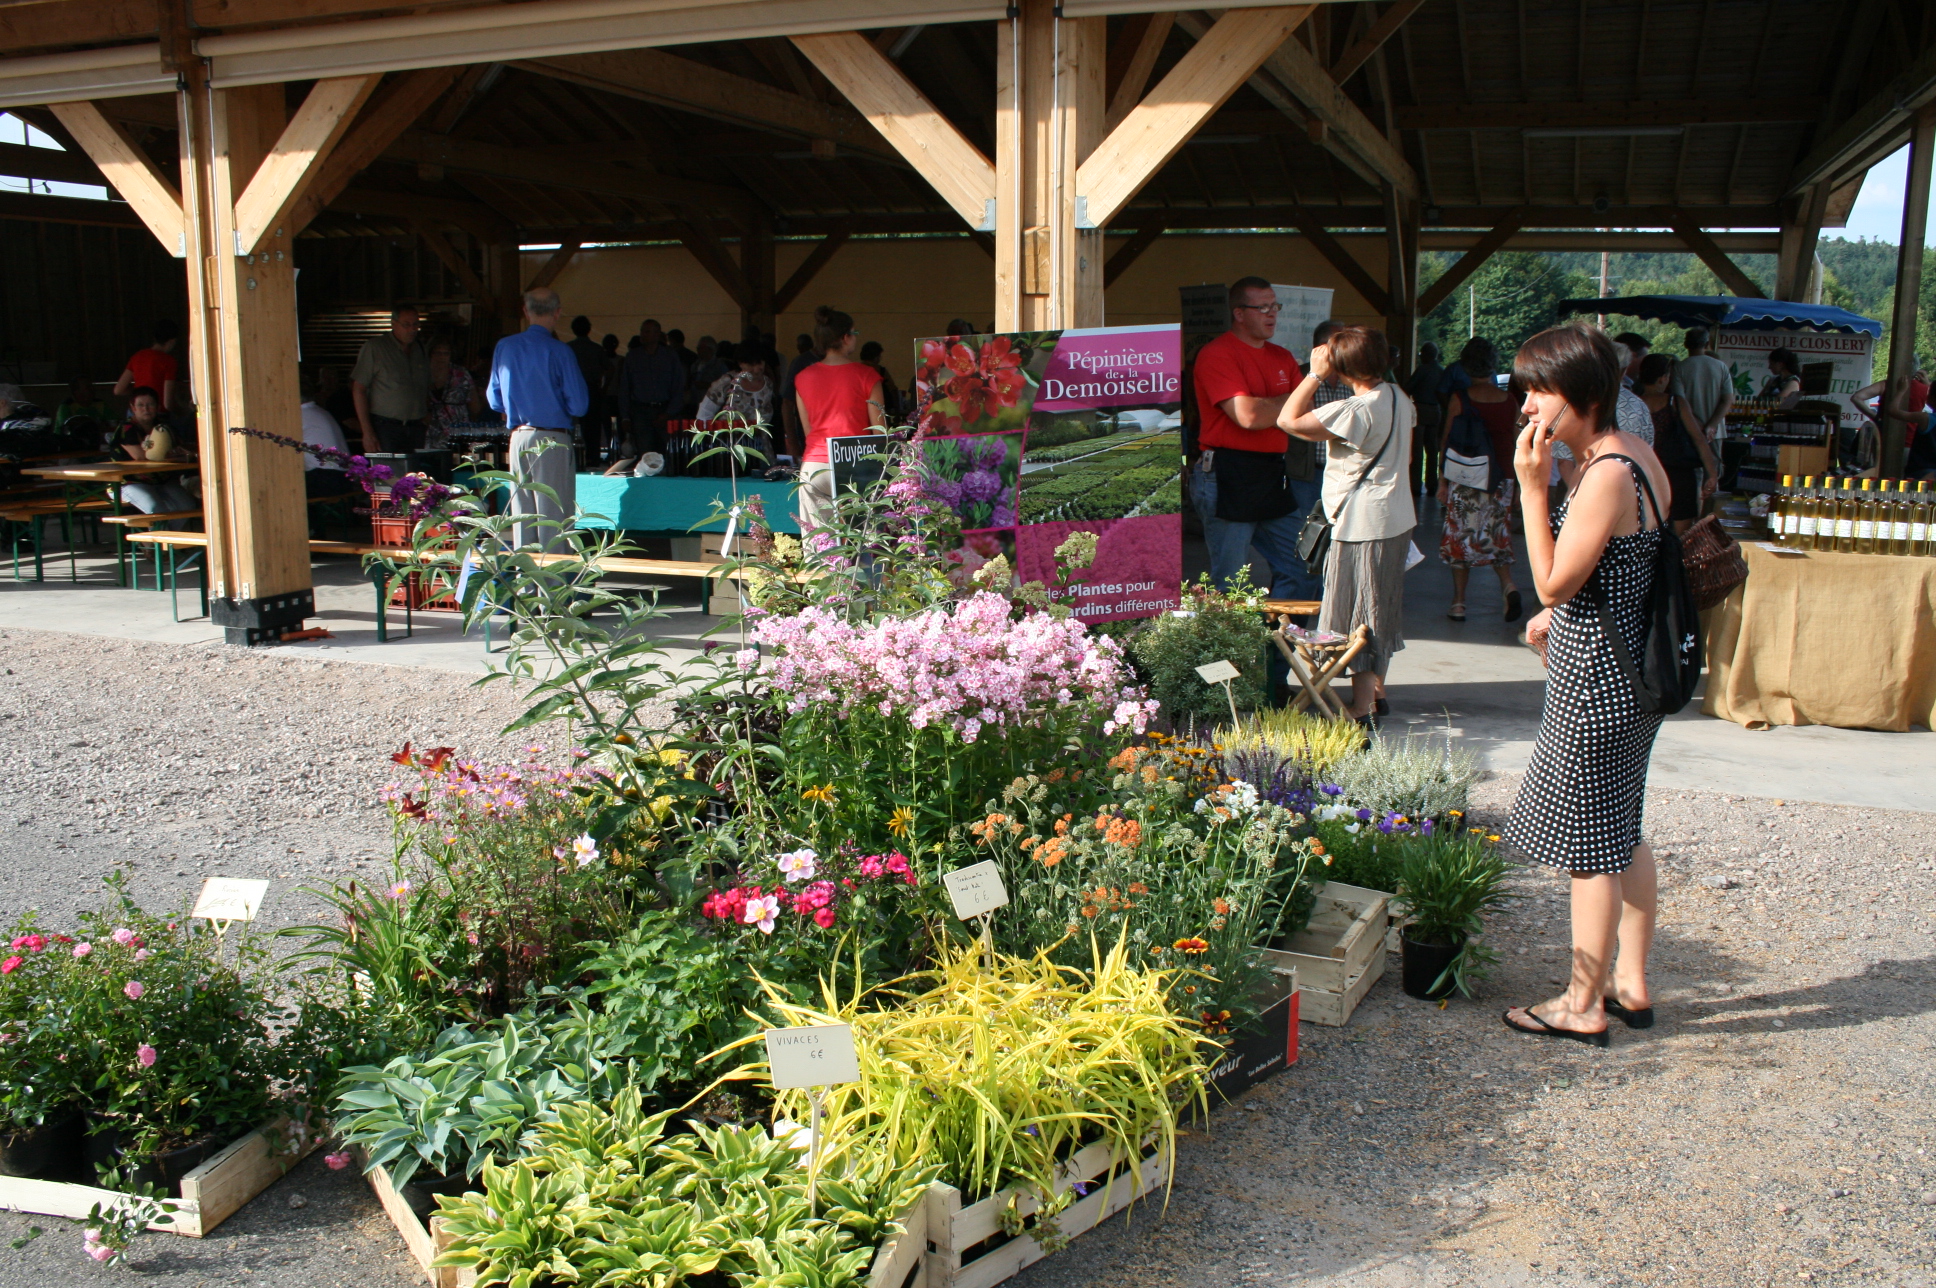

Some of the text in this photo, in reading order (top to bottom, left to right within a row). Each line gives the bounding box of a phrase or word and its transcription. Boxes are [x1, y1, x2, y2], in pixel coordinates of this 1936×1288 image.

[1719, 334, 1868, 350] DOMAINE LE CLOS LERY
[1068, 348, 1164, 375] Pépinières
[1105, 368, 1139, 379] de la
[1044, 372, 1178, 400] Demoiselle
[833, 439, 878, 468] Bruyères
[1068, 583, 1123, 597] Plantes
[1125, 581, 1156, 595] pour
[1069, 598, 1177, 618] ardins différents.
[776, 1034, 820, 1046] VIVACES
